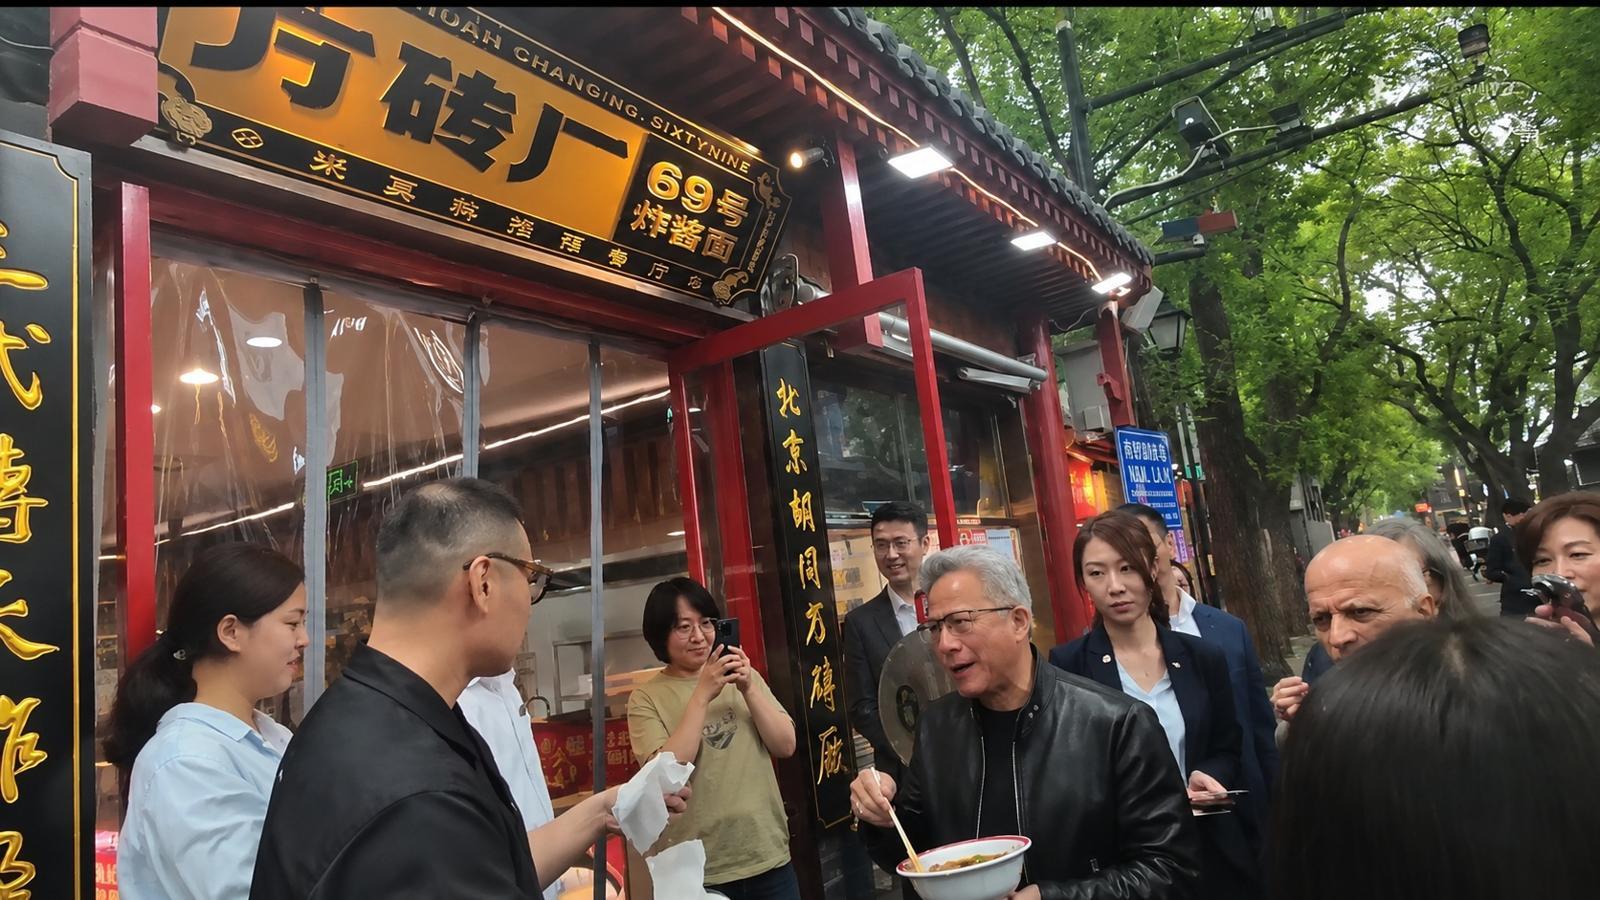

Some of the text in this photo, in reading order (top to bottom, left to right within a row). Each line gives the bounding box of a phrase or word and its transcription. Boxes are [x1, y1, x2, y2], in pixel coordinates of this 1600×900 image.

[650, 115, 751, 174] SIXTYNINE
[646, 161, 750, 229] 69号
[630, 199, 741, 265] 炸酱面
